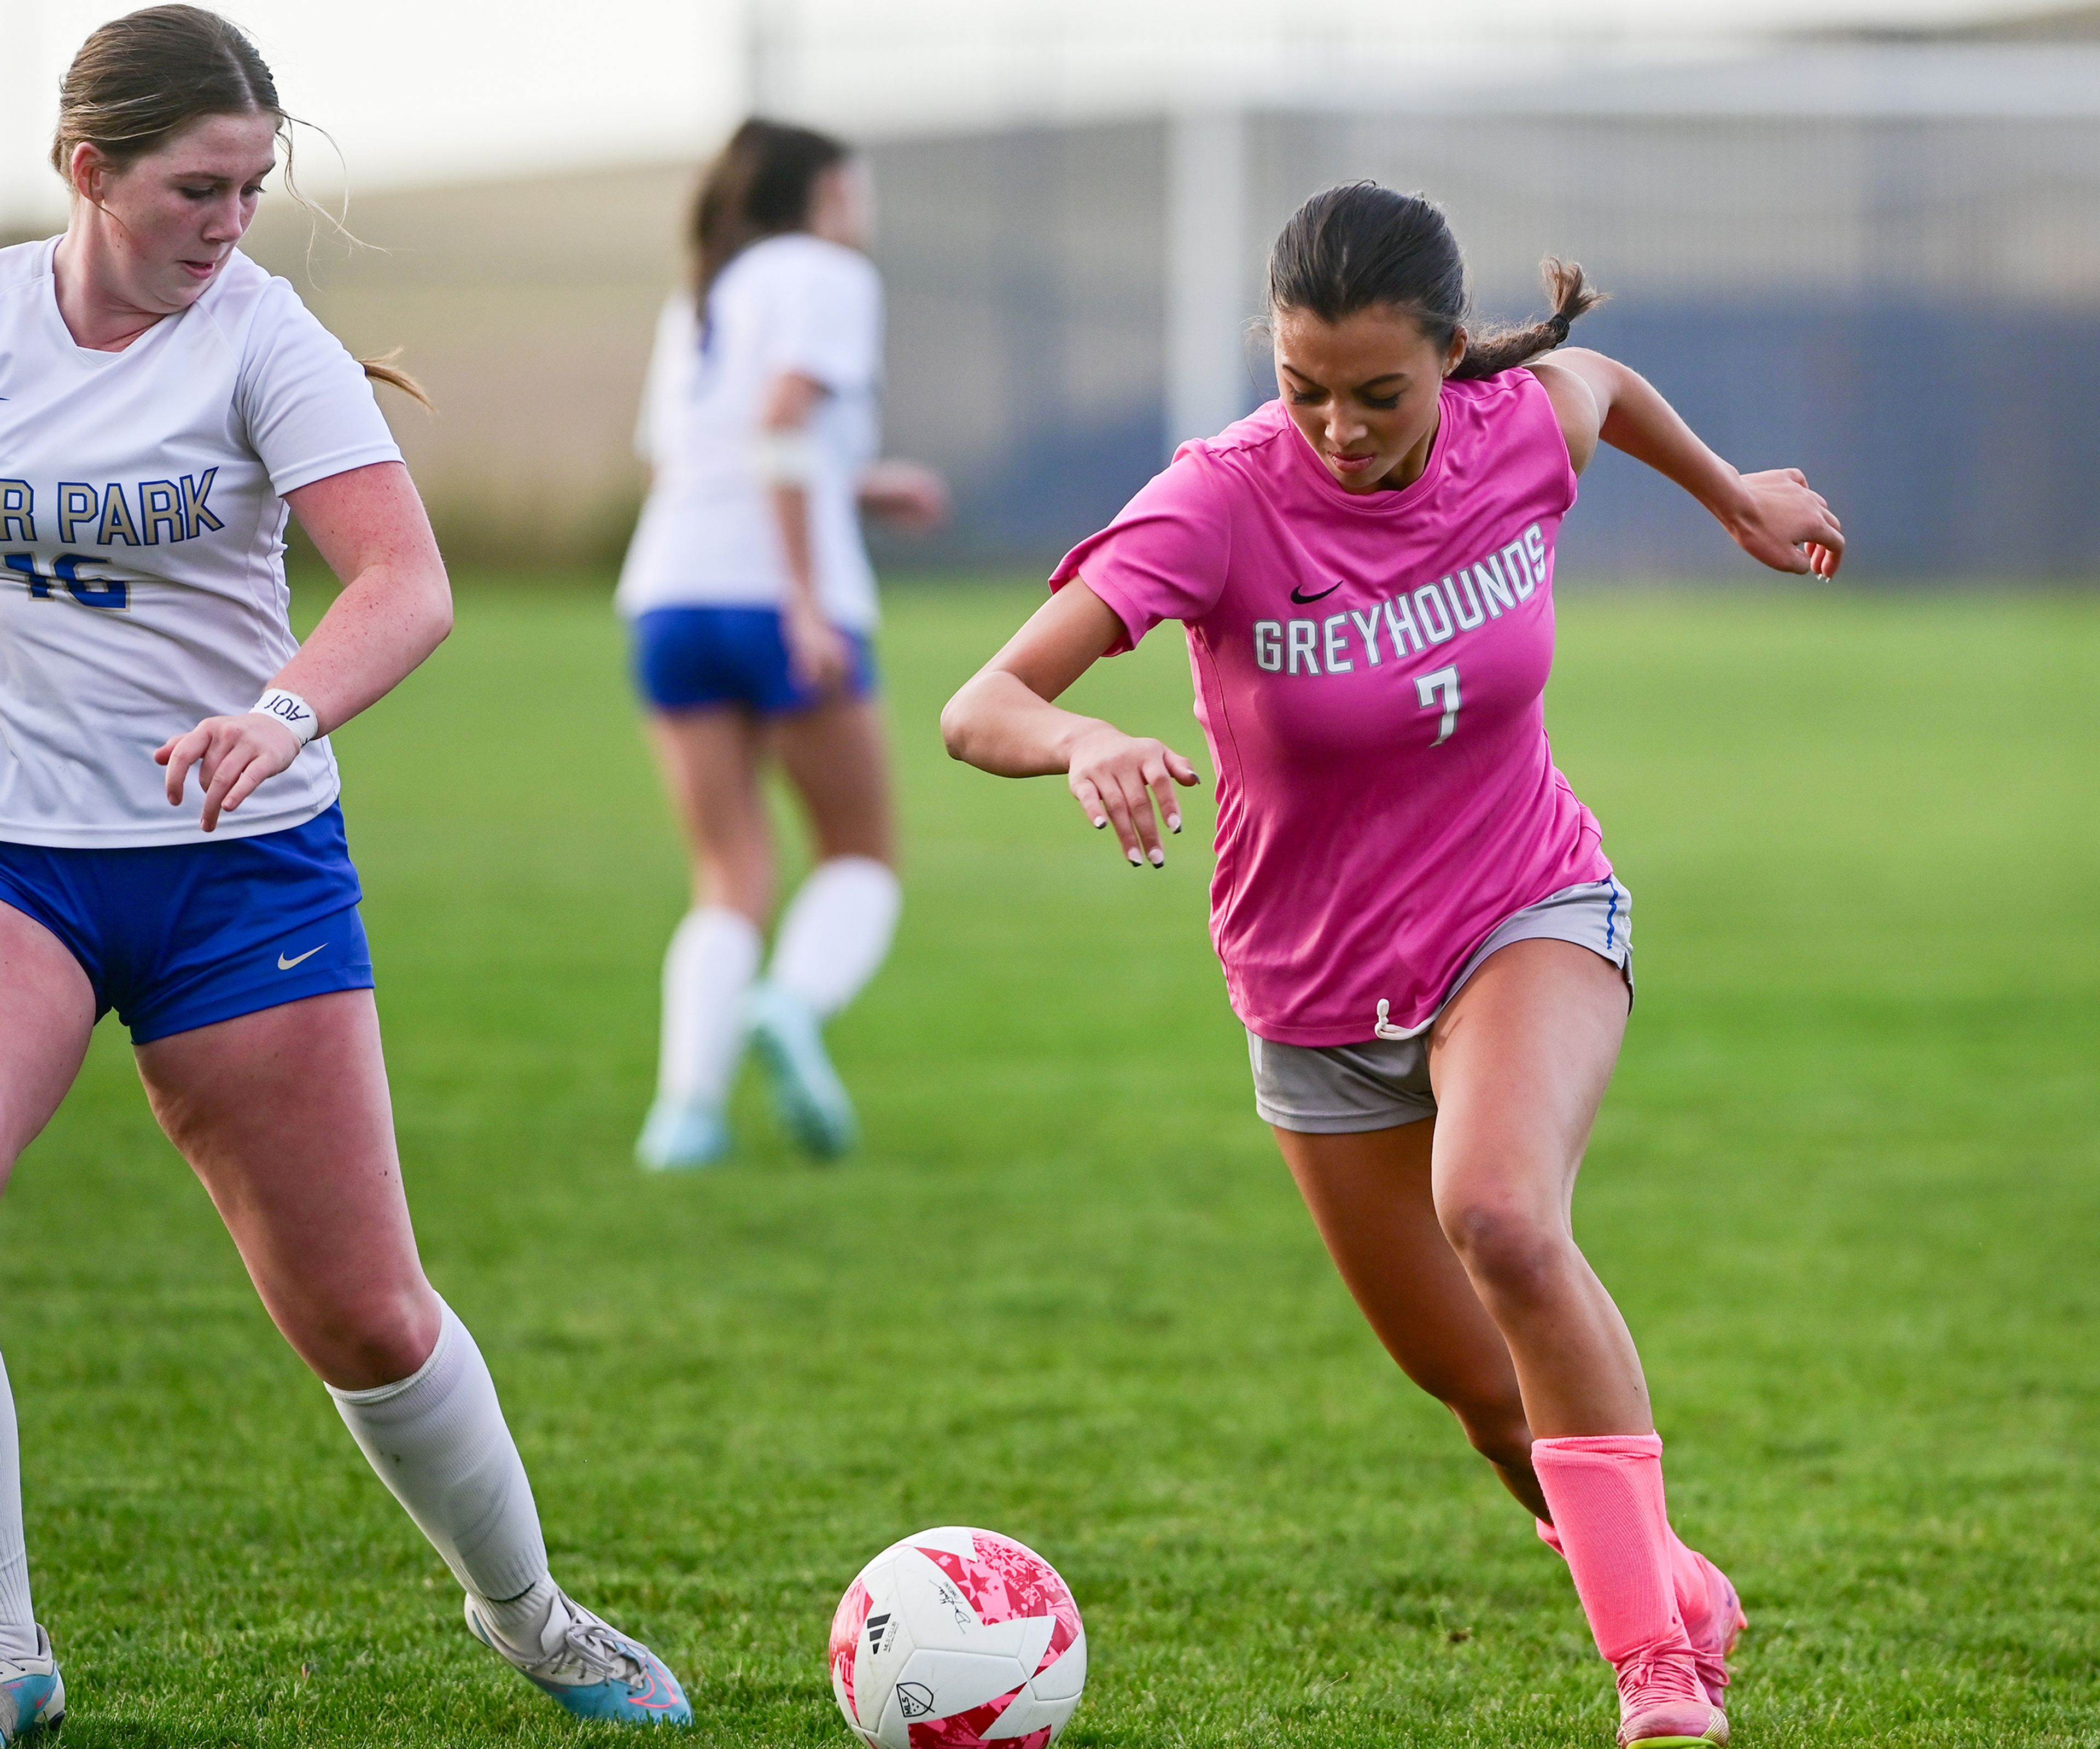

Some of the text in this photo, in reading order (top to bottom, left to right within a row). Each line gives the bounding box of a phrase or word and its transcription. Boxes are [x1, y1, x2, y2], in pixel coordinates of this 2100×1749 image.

[0, 466, 225, 546] R PARK
[1, 551, 131, 613] 16
[1253, 522, 1545, 675] GREYHOUNDS
[1413, 663, 1461, 749] 7
[901, 1696, 912, 1715] MLS
